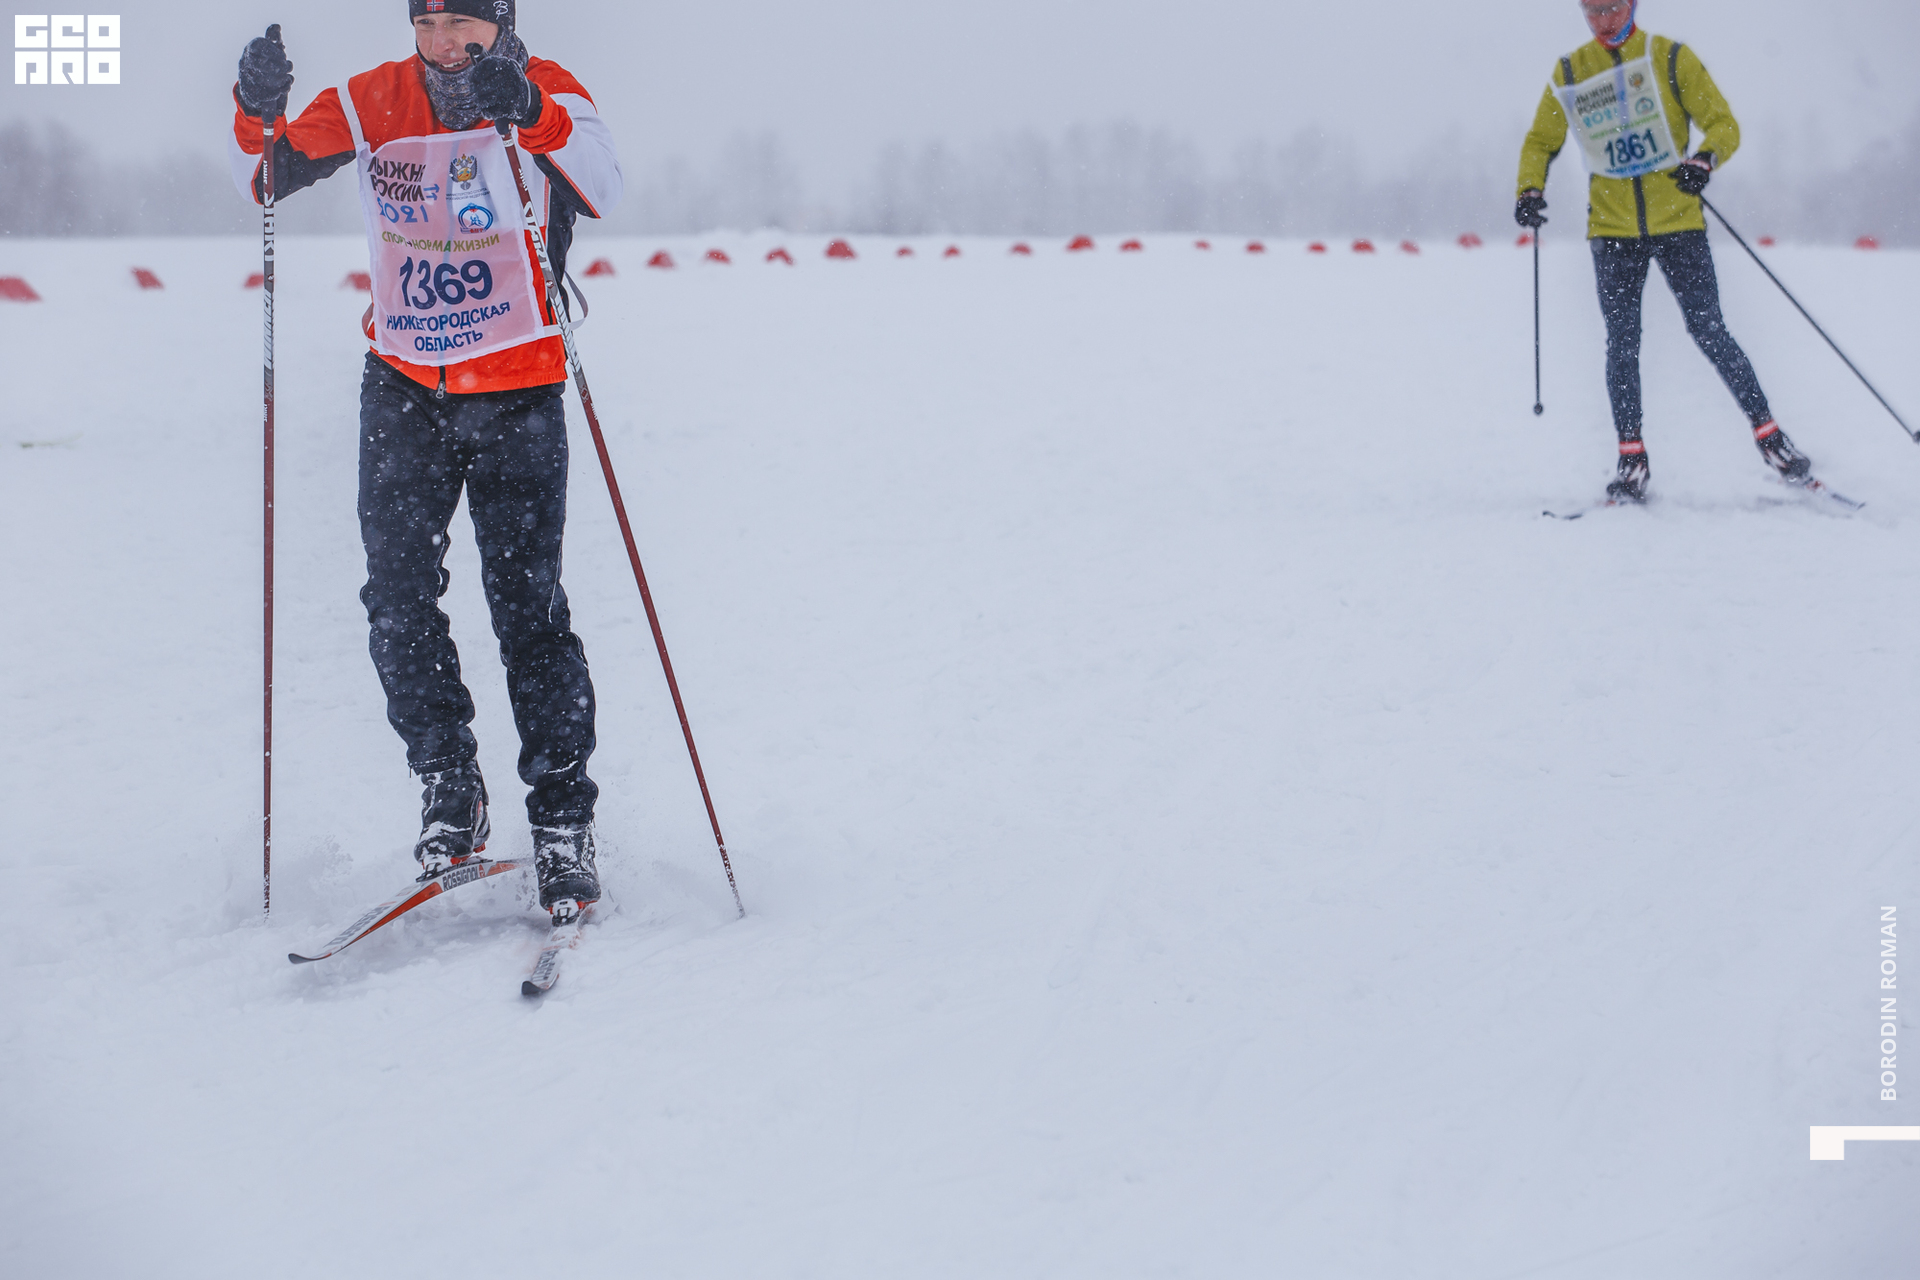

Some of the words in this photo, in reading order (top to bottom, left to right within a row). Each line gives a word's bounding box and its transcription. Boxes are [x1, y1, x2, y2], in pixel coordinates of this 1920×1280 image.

[1605, 129, 1658, 168] 1861
[370, 174, 426, 202] РОССИИ
[377, 197, 429, 223] 2021
[453, 234, 500, 252] ЖИЗНИ
[399, 256, 493, 310] 1369
[386, 301, 511, 332] НИЖЕГОРОДСКАЯ
[414, 330, 483, 352] ОБЛАСТЬ
[442, 866, 480, 892] ROSSIGNOL
